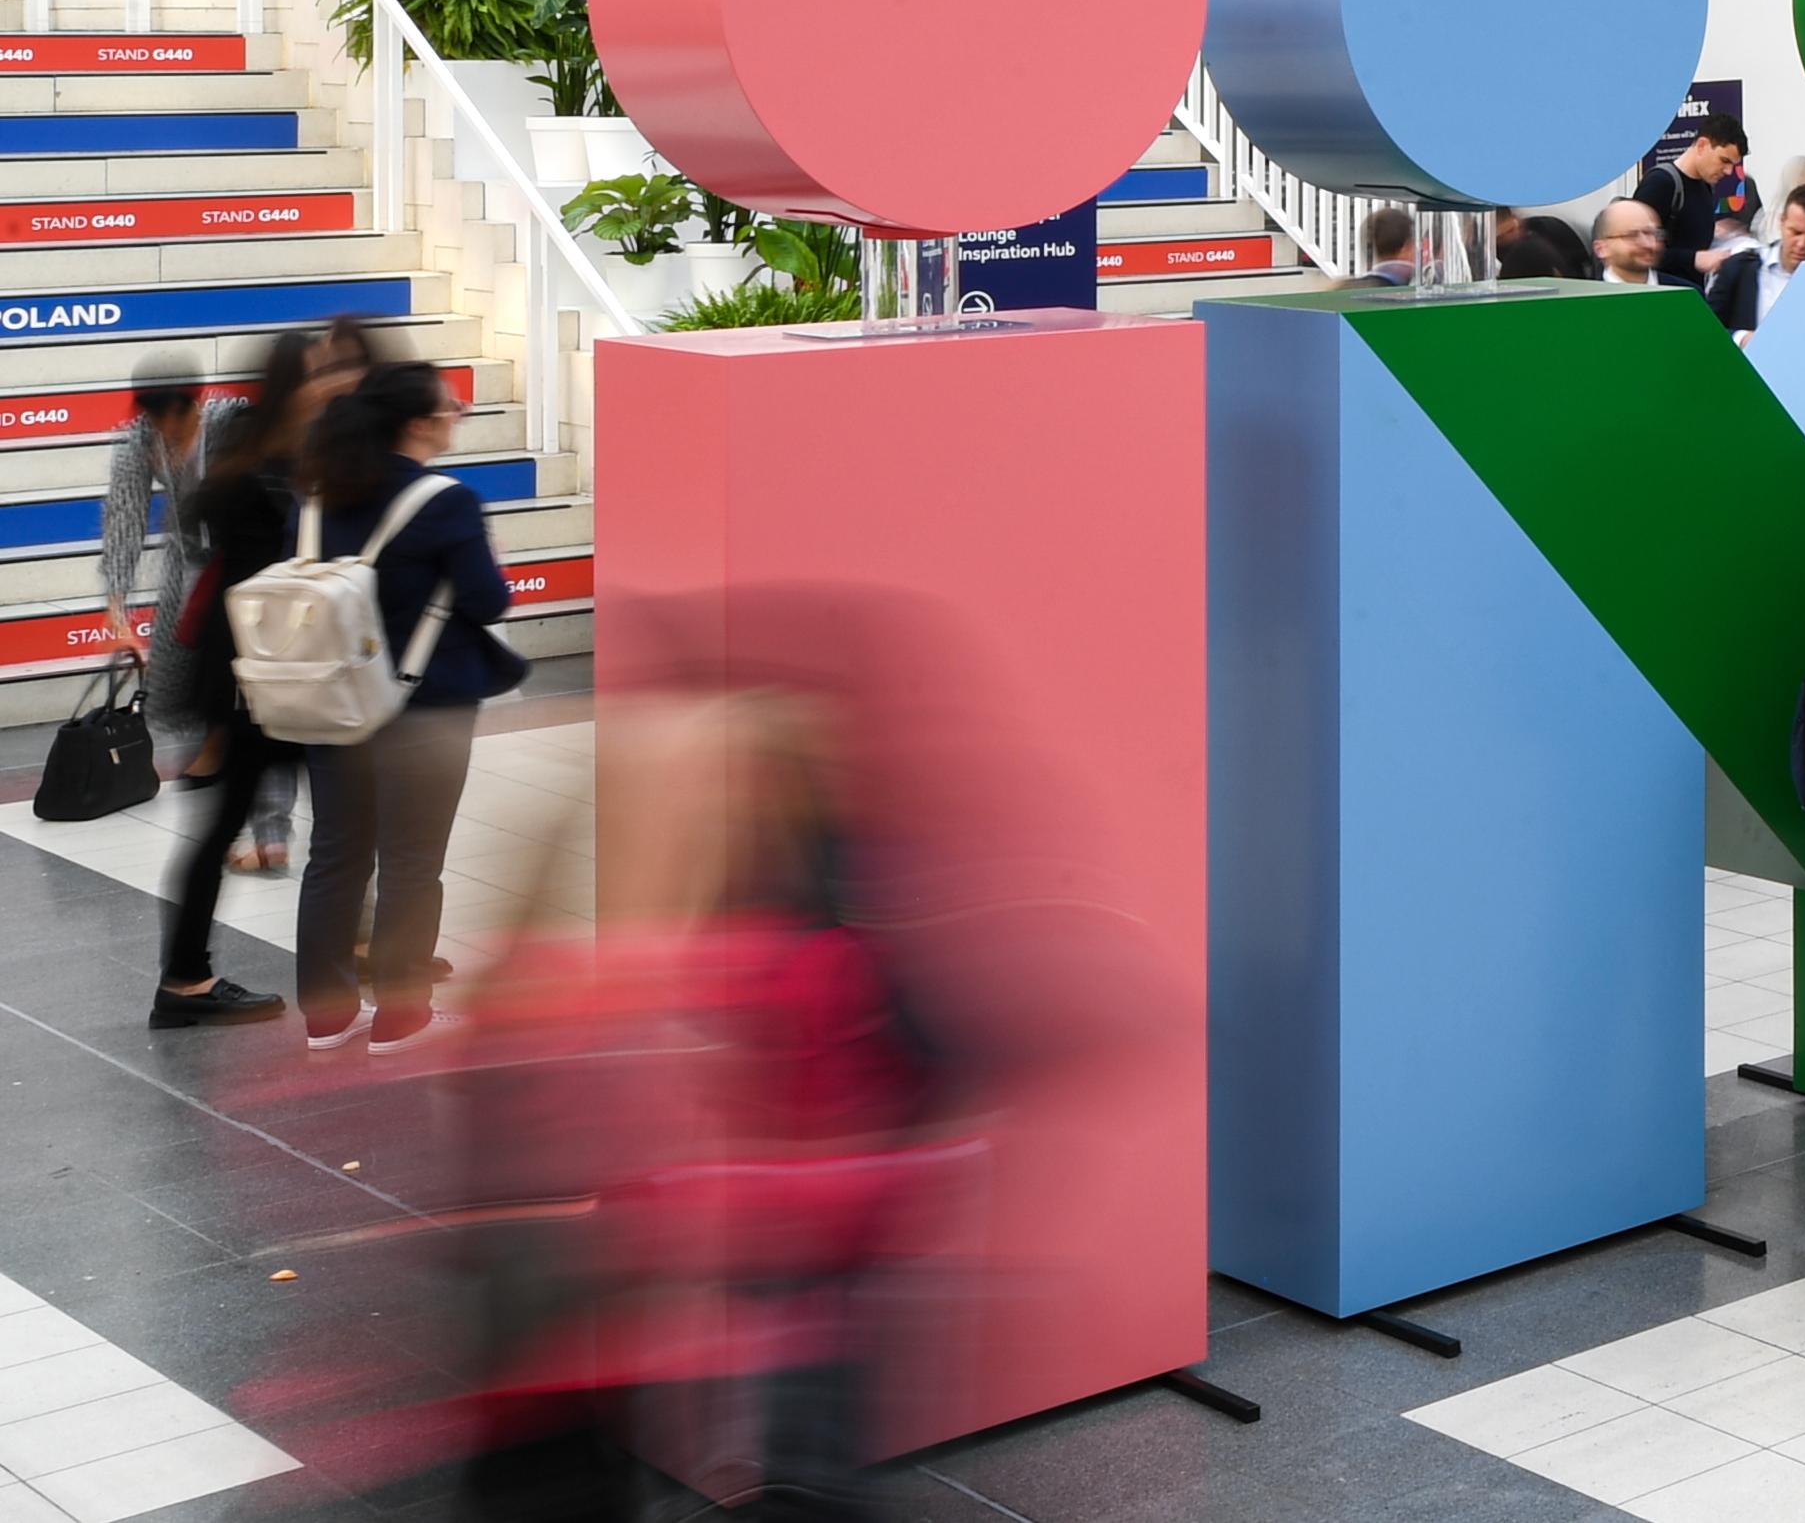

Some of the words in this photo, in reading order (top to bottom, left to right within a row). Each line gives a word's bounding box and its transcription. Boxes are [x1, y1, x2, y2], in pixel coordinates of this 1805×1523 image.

[97, 48, 150, 61] STAND
[152, 48, 194, 61] G440
[31, 216, 88, 231] STAND
[91, 214, 136, 228] G440
[201, 210, 255, 224] STAND
[257, 208, 300, 221] G440
[957, 229, 1017, 246] Lounge
[957, 245, 1040, 264] Inspiration
[1043, 241, 1076, 257] Hub
[1167, 251, 1204, 265] STAND
[1206, 249, 1235, 262] G440
[0, 303, 121, 330] OLAND
[20, 408, 69, 424] G440
